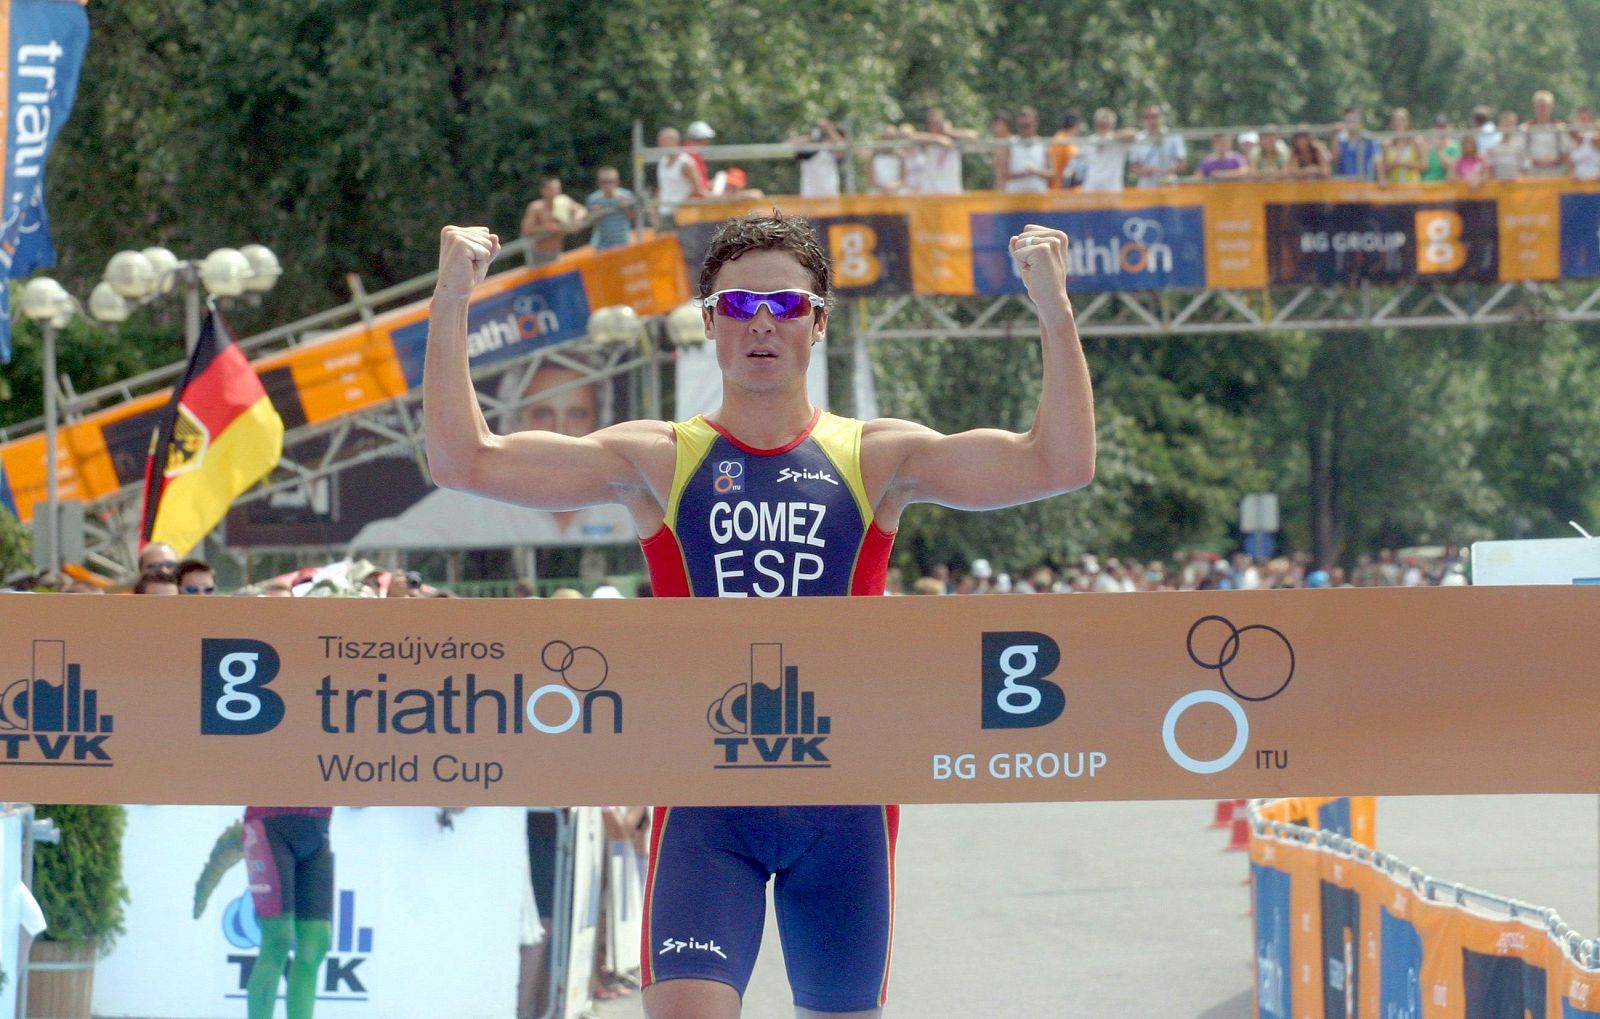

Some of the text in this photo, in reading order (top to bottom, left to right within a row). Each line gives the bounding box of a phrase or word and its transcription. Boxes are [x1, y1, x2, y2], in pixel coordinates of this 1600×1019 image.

[1332, 230, 1406, 253] GROUP
[467, 308, 560, 359] athlon
[776, 467, 839, 486] Spiuk
[709, 500, 827, 548] GOMEZ
[714, 549, 825, 598] ESP
[318, 635, 505, 665] Tiszaújváros
[316, 673, 623, 734] triathlon
[0, 734, 112, 760] TVK
[714, 737, 830, 762] TVK
[1255, 750, 1288, 769] ITU
[318, 754, 504, 789] World Cup
[932, 751, 1107, 780] BG GROUP
[659, 937, 727, 959] Spiuk
[226, 954, 368, 993] TK
